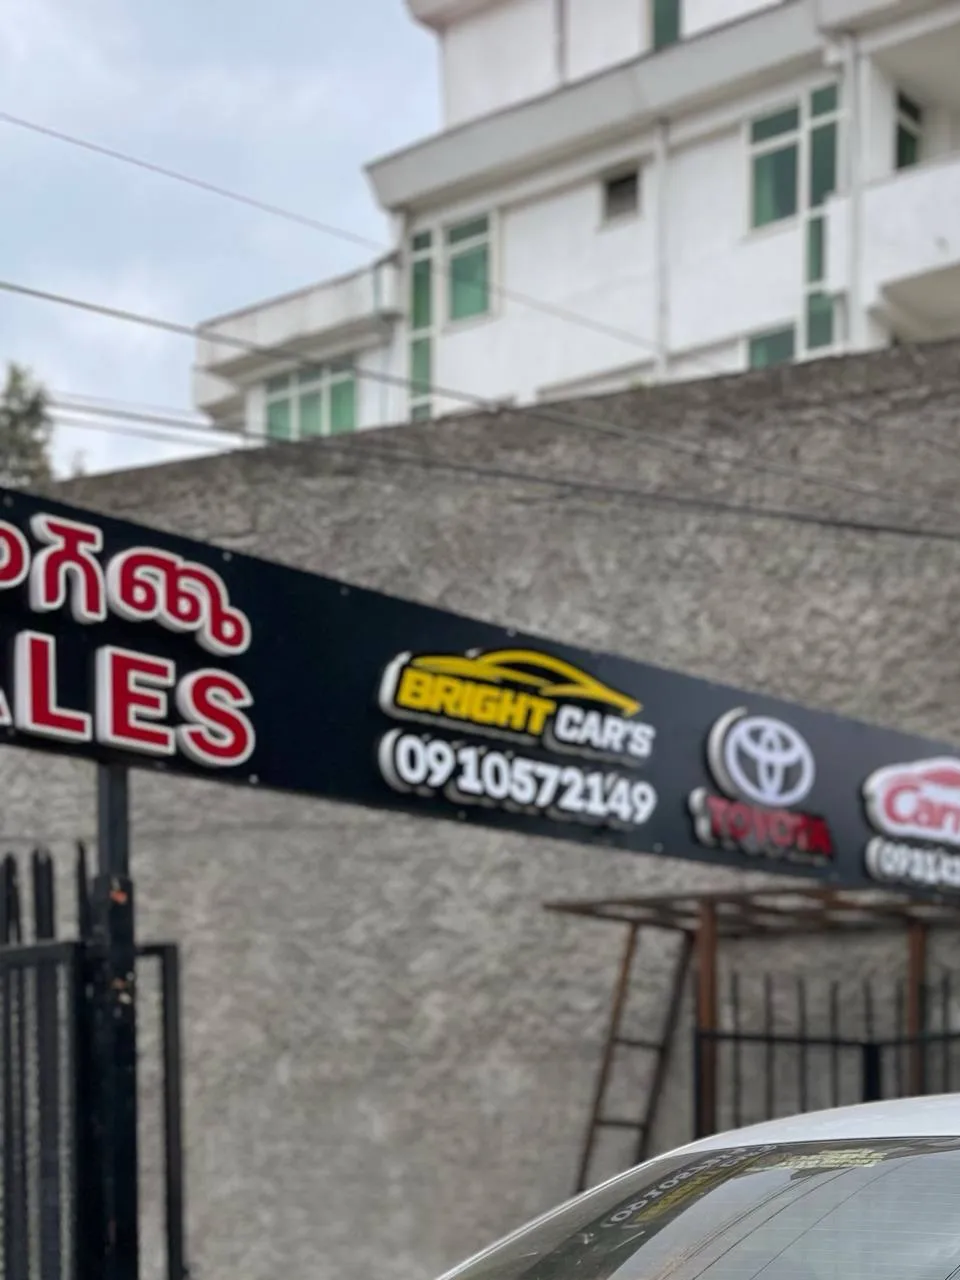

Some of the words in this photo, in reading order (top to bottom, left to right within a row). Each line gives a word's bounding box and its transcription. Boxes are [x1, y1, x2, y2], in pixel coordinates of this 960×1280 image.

[0, 630, 257, 767] LES
[397, 666, 557, 736] BRIGHT
[554, 704, 656, 758] CAR'S
[396, 733, 658, 824] 0910572149
